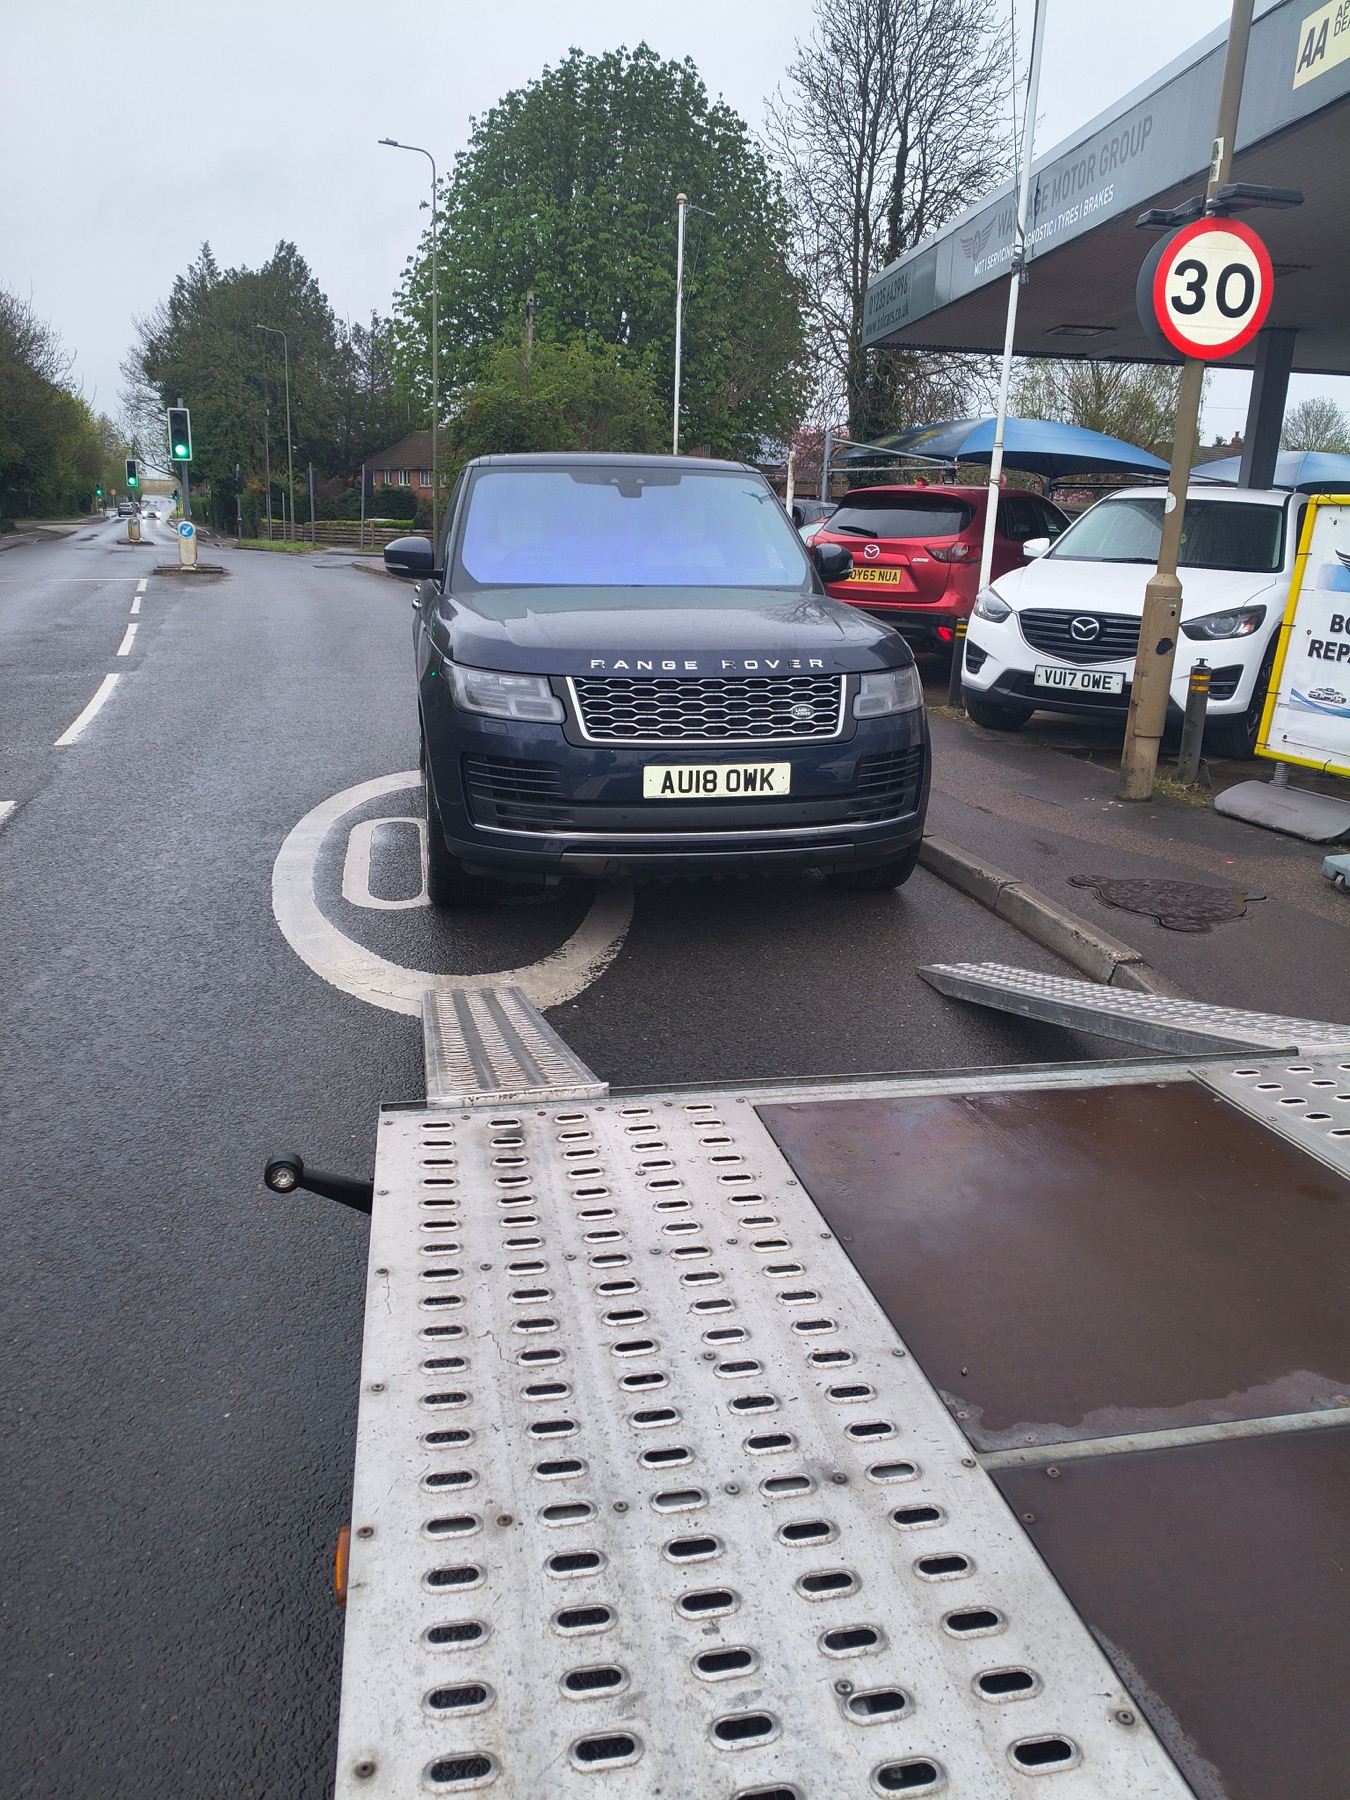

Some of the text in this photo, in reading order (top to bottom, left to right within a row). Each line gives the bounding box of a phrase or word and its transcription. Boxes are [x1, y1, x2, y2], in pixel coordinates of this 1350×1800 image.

[1297, 17, 1330, 74] AA
[1052, 153, 1096, 207] MOTOR
[1100, 115, 1153, 176] GROUP
[1083, 184, 1114, 217] BRAKES
[1171, 259, 1255, 318] 30
[878, 570, 898, 582] NUA
[1307, 639, 1350, 664] REP
[590, 659, 824, 670] RANGE ROVER
[1045, 669, 1113, 690] VU17 OWE
[661, 768, 775, 793] AU18 OWK
